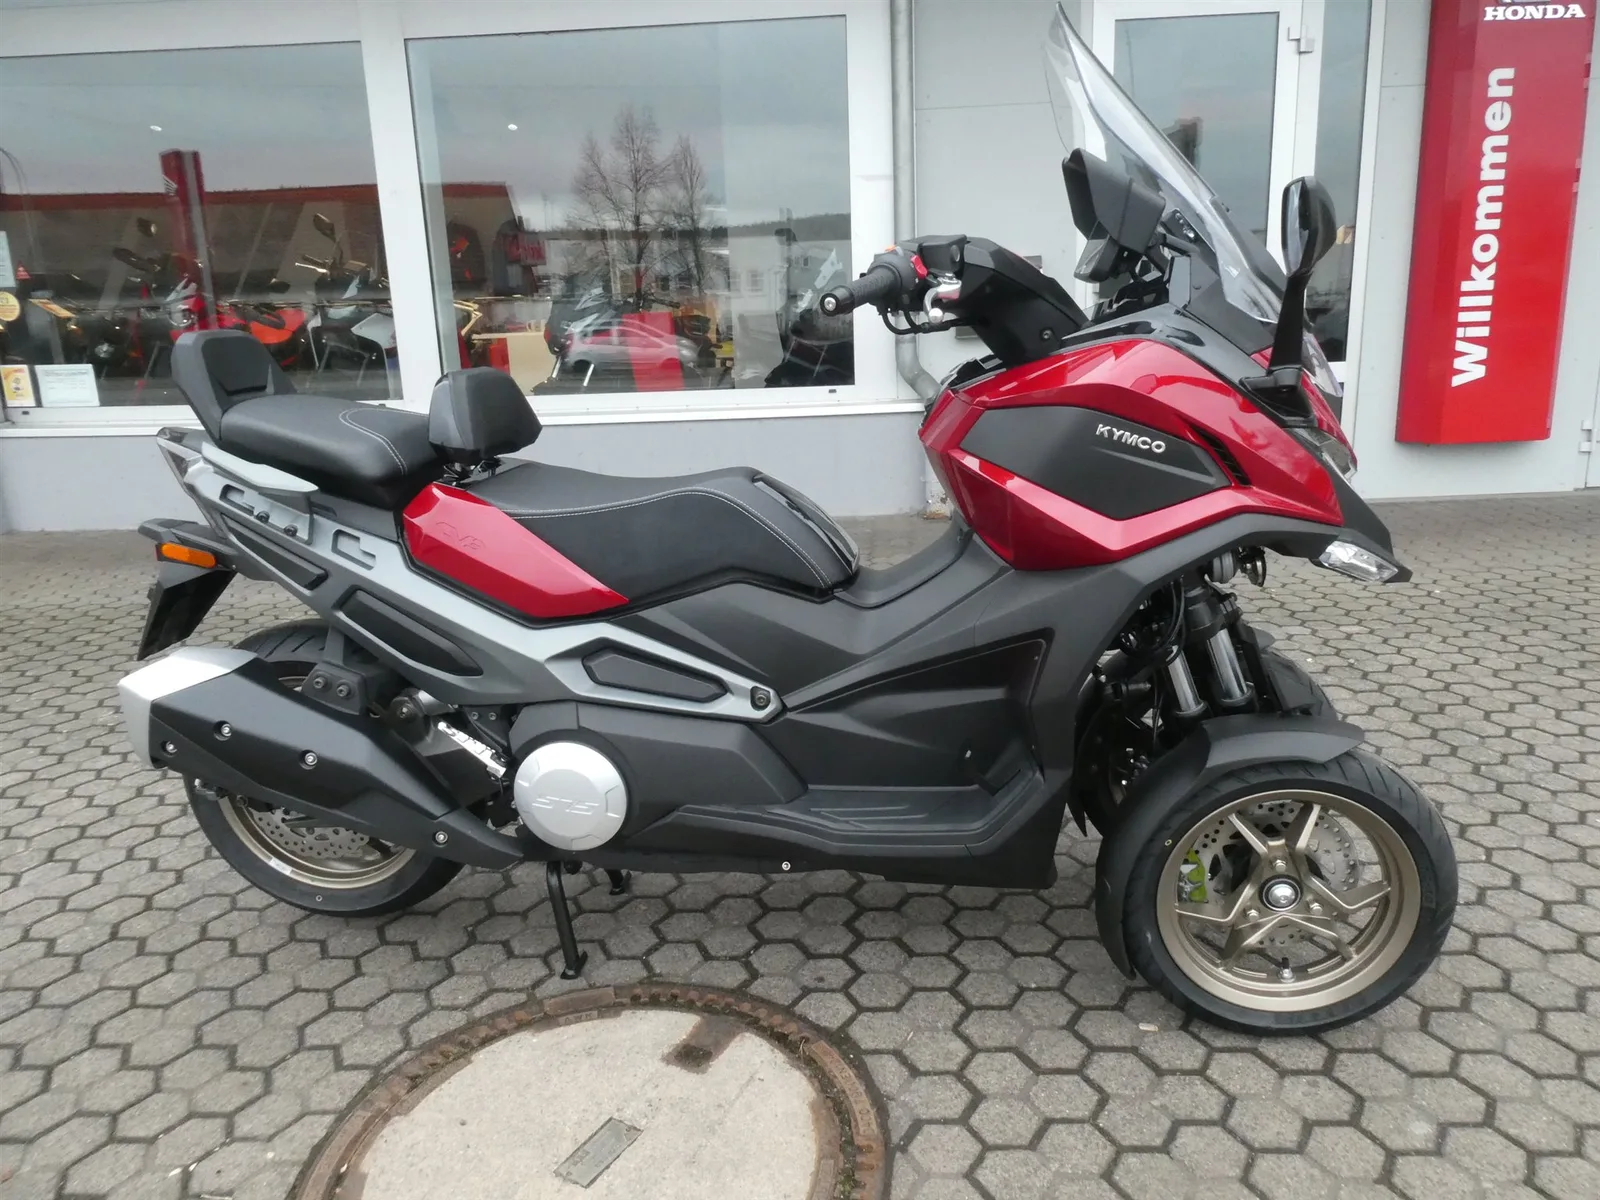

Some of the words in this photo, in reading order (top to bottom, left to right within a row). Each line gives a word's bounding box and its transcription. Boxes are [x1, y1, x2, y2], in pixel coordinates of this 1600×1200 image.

[1484, 4, 1586, 20] HONDA
[1451, 67, 1515, 388] Willkommen
[1095, 423, 1166, 453] KYMCO
